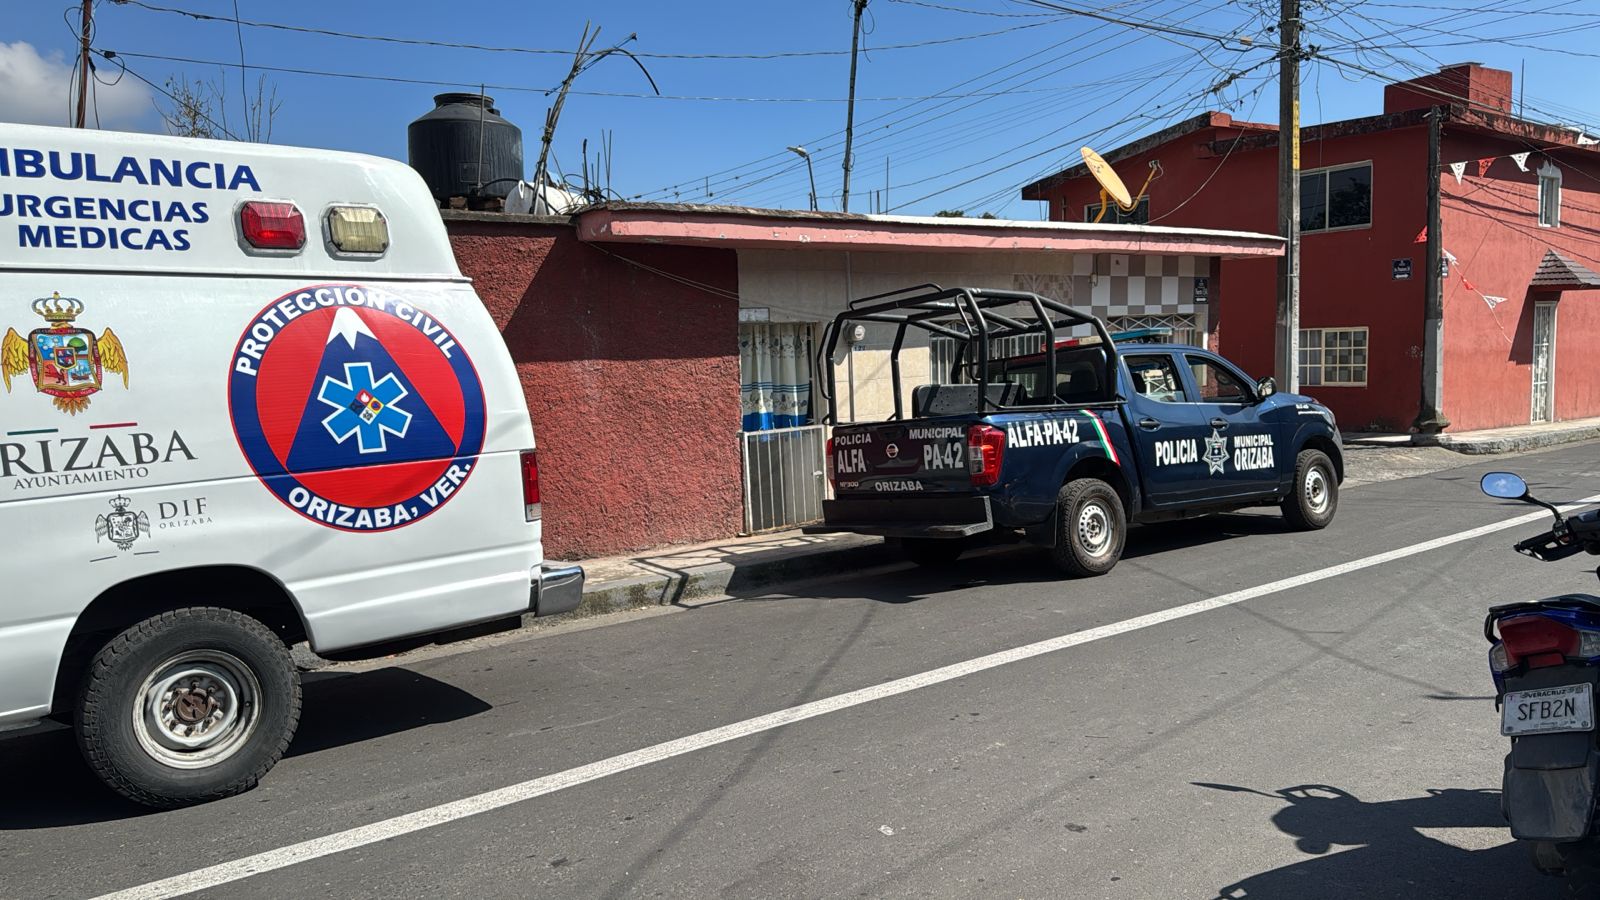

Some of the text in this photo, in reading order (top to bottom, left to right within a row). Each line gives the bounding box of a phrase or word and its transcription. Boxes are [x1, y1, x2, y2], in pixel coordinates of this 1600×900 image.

[18, 224, 191, 251] MEDICAS
[235, 286, 459, 377] PROTECCIÓN CIVIL
[835, 427, 965, 447] POLICIA MUNICIPAL
[1007, 417, 1080, 448] ALFA-PA-42
[1233, 434, 1274, 448] MUNICIPAL
[837, 442, 964, 473] ALFA PA-42
[1154, 438, 1198, 467] POLICIA
[1233, 446, 1275, 472] ORIZABA
[14, 466, 149, 490] AYUNTAMIENTO
[875, 480, 924, 492] ORIZABA
[157, 497, 207, 519] DIF
[288, 463, 472, 529] ORIZABA, VER.
[159, 516, 212, 529] ORIZABA
[1517, 698, 1575, 721] SFB2N
